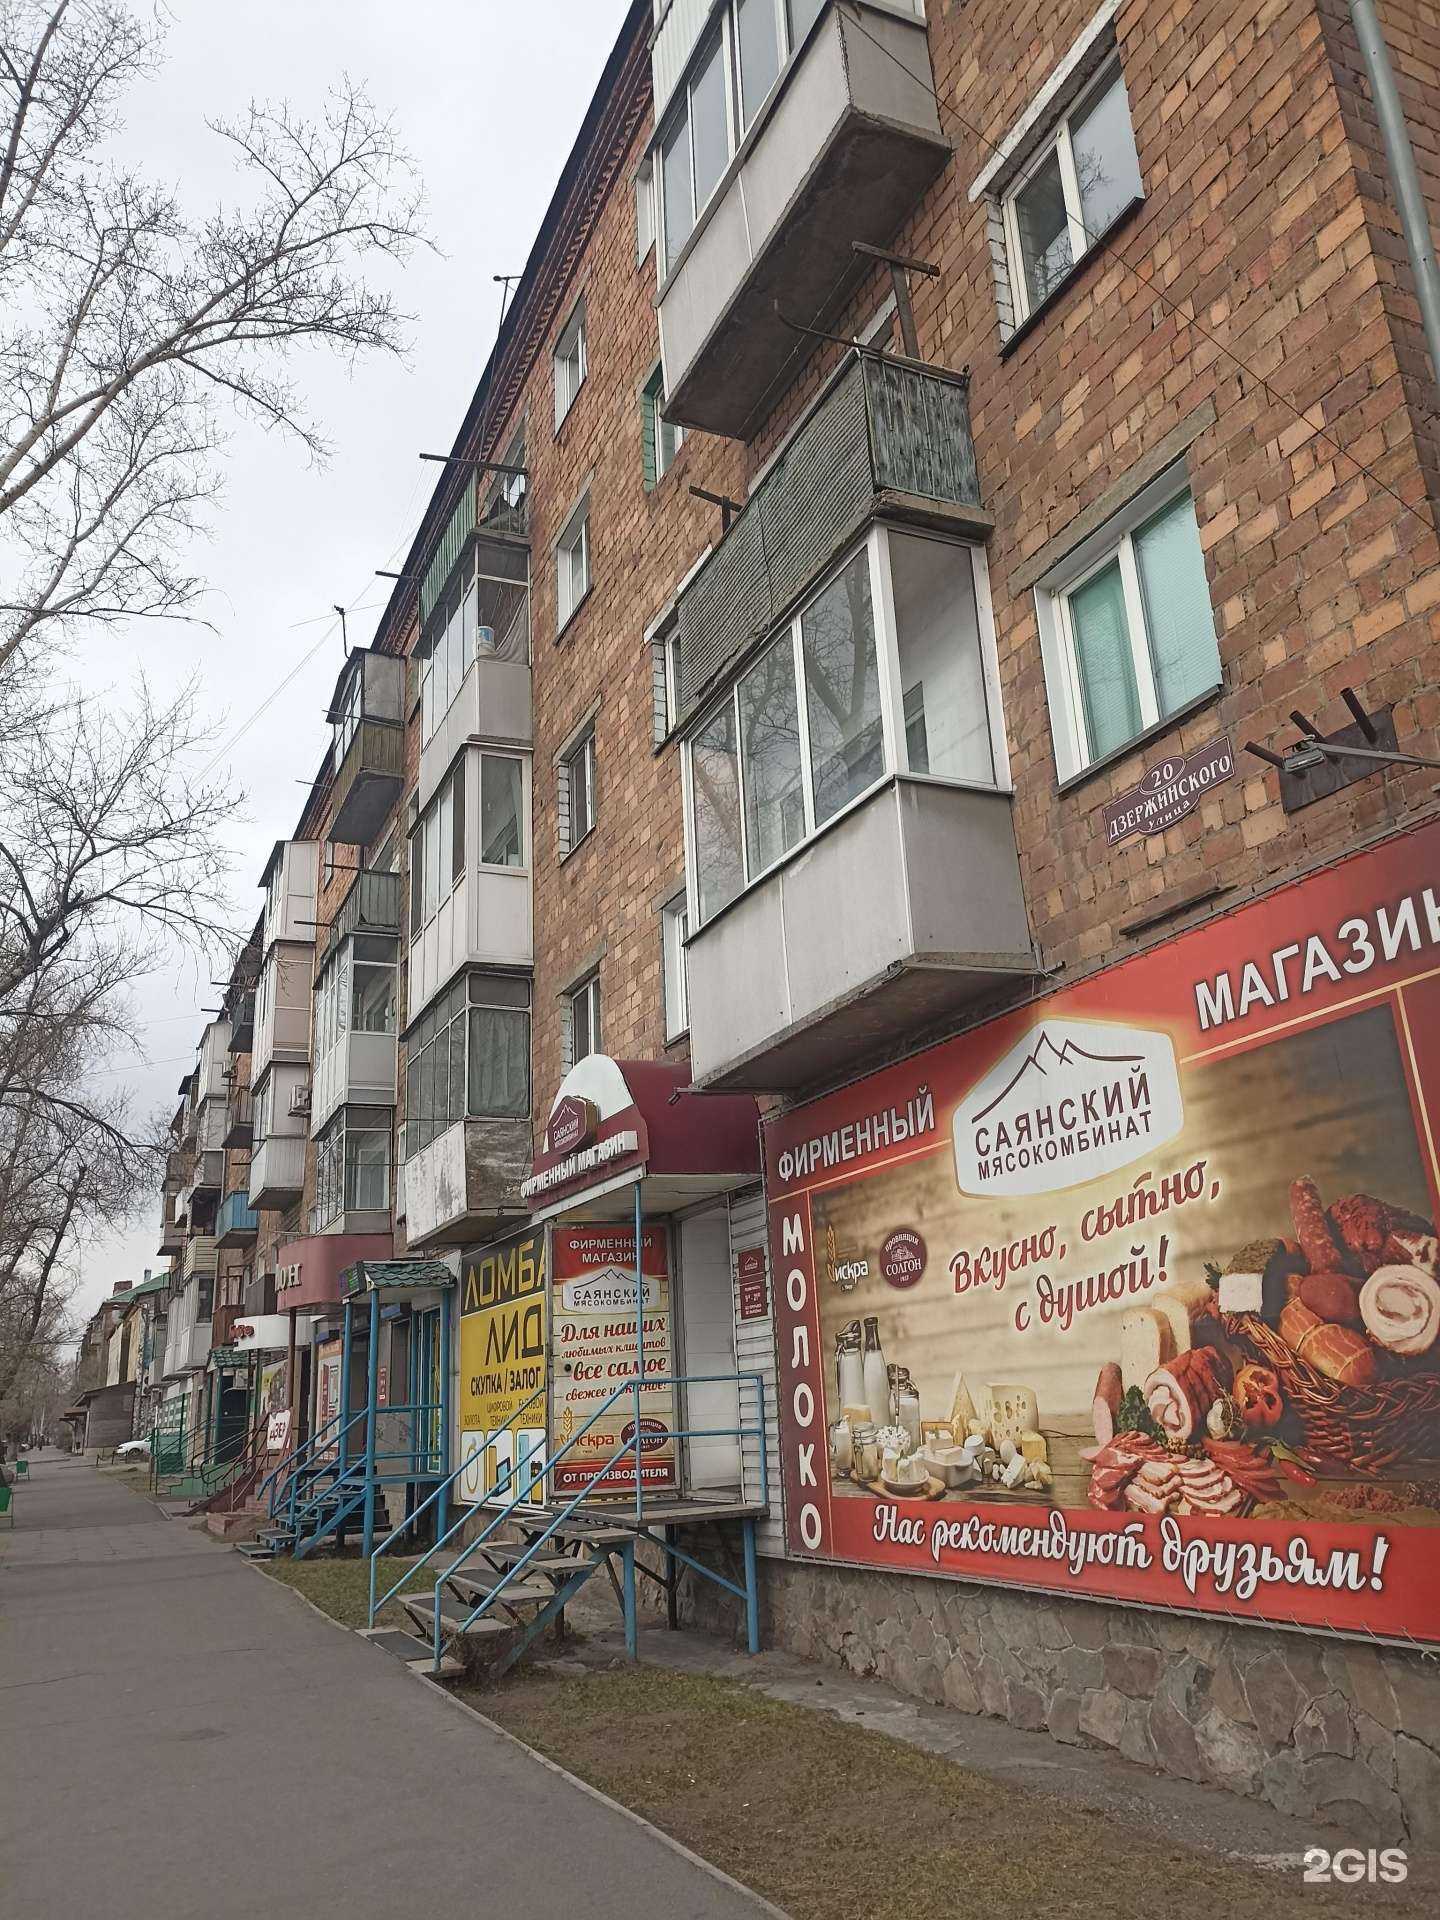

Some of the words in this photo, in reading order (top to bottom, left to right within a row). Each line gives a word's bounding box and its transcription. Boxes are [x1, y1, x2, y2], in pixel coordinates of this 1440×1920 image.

[1151, 763, 1174, 788] 20
[1109, 755, 1230, 840] ДЗЕРЖИНСКОГО
[1148, 800, 1190, 830] улица
[974, 1065, 1152, 1157] САЯНСКИЙ
[777, 1085, 936, 1182] ФИРМЕННЫЙ
[978, 1110, 1153, 1181] МЯСОКОМБИНАТ
[520, 1153, 578, 1199] ФИРМЕННЫЙ
[949, 1225, 1067, 1294] Вкусно,
[1081, 1160, 1220, 1242] сытно,
[834, 1260, 869, 1284] искра
[886, 1258, 922, 1276] СОЛГОН
[1015, 1302, 1031, 1331] с
[1036, 1235, 1169, 1332] душой!
[561, 1323, 600, 1343] Для
[562, 1346, 614, 1359] любимых
[470, 1371, 502, 1396] СКУПКА
[509, 1366, 541, 1392] ЗАЛОГ
[573, 1361, 603, 1381] все
[782, 1213, 822, 1550] МОЛОКО
[565, 1387, 606, 1401] свежее
[563, 1473, 579, 1483] ОТ
[873, 1504, 925, 1546] Нас
[931, 1510, 1153, 1575] рекомендуют
[1160, 1516, 1389, 1599] друзьям!
